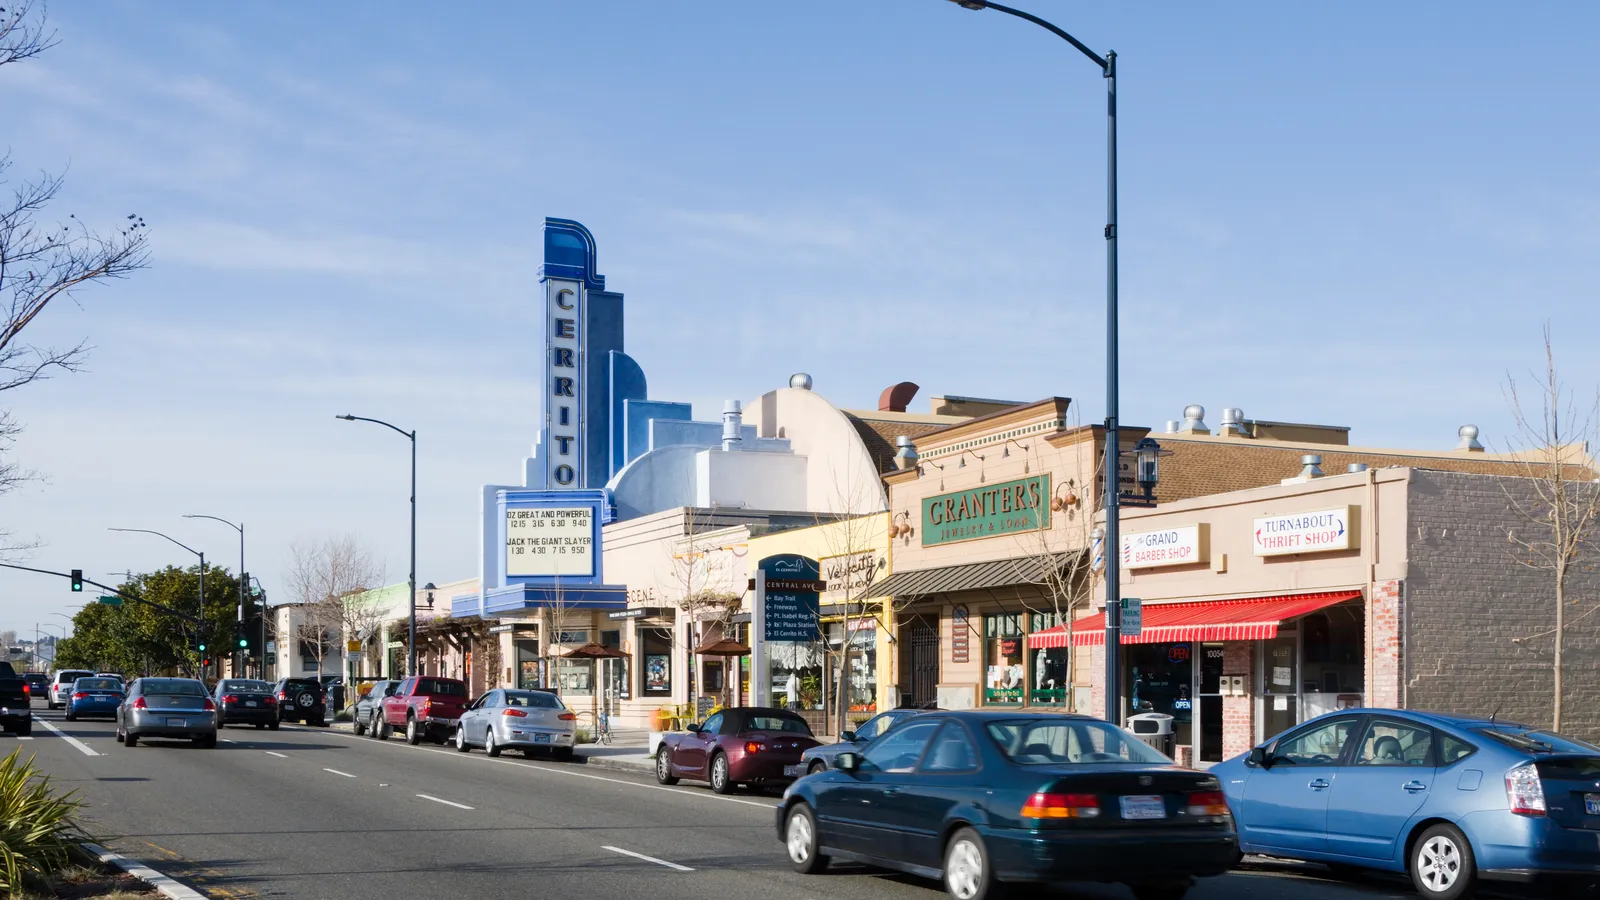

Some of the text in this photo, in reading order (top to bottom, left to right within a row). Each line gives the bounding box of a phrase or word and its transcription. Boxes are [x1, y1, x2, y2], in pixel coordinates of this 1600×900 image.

[554, 288, 575, 485] CERRITO
[507, 510, 591, 519] OZ GREAT AND POWERFUL
[941, 516, 1028, 540] JEWELRY & LOAN
[1265, 514, 1334, 533] TURNABOUT
[507, 537, 591, 546] JACK THE GIANT SLAYER
[1145, 531, 1178, 547] GRAND
[1264, 530, 1337, 549] THRIFT SHOP
[1135, 546, 1191, 563] BARBER SHOP
[626, 587, 655, 604] SCENE
[1169, 648, 1189, 660] OPEN
[1207, 650, 1224, 658] 10054
[1175, 701, 1191, 709] OPEN
